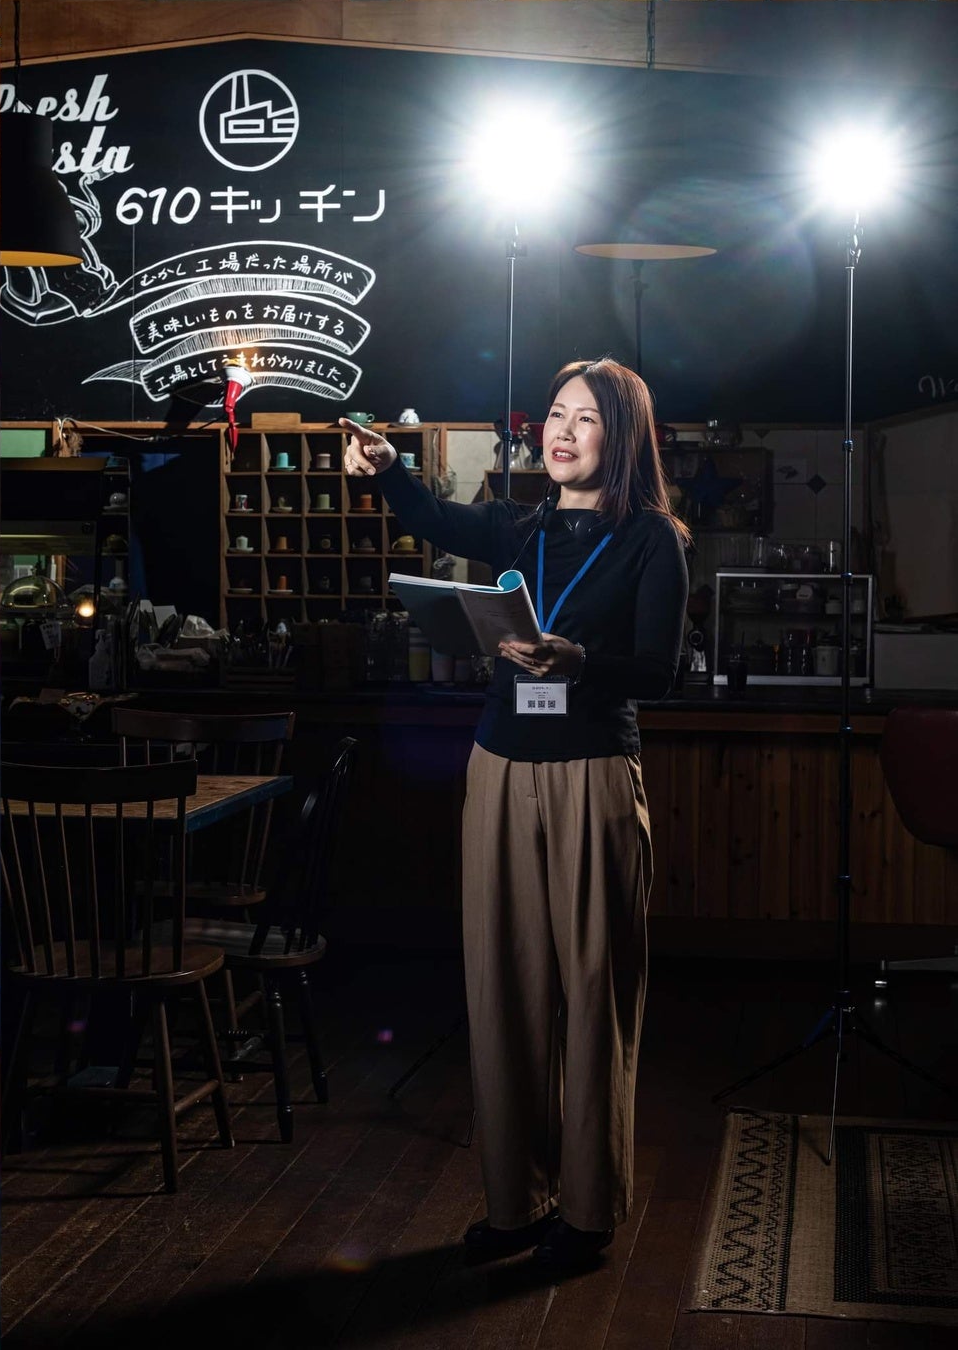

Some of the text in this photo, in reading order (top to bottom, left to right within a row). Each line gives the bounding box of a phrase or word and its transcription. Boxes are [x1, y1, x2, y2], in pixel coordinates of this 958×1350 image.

[52, 126, 135, 175] sta
[116, 184, 386, 225] 610キッチン
[146, 303, 346, 342] 美味しいものをお届けする
